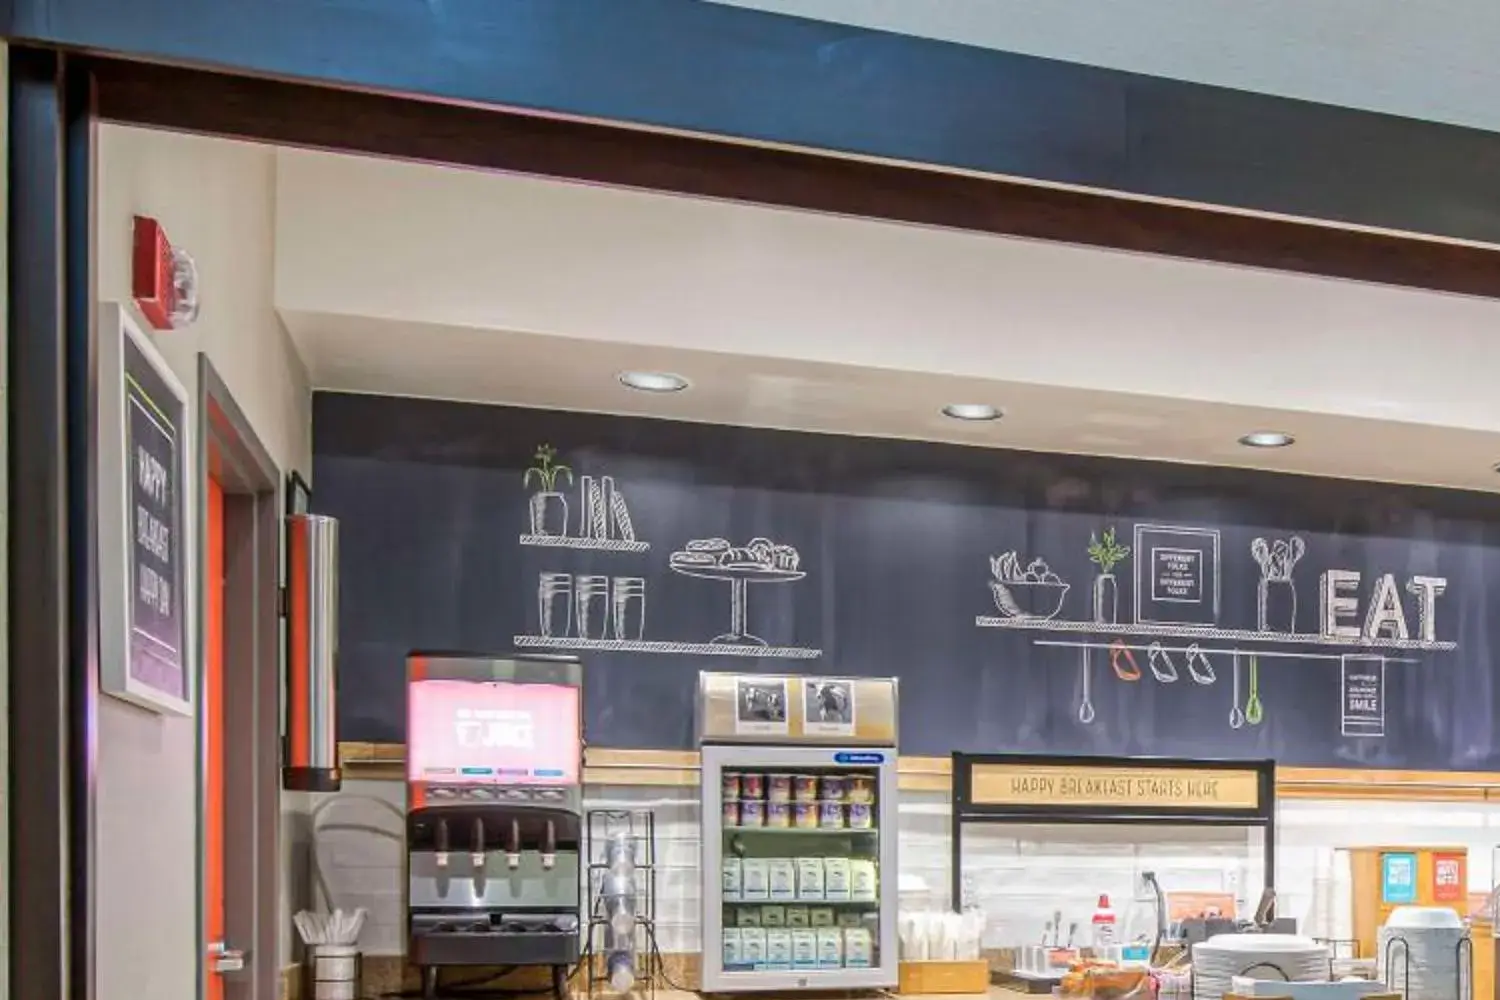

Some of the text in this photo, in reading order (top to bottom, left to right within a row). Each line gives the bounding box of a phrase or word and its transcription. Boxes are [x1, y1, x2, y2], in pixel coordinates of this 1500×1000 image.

[1320, 569, 1447, 642] EAT
[1011, 777, 1219, 799] HAPPY BREAKFAST STARTS HERE
